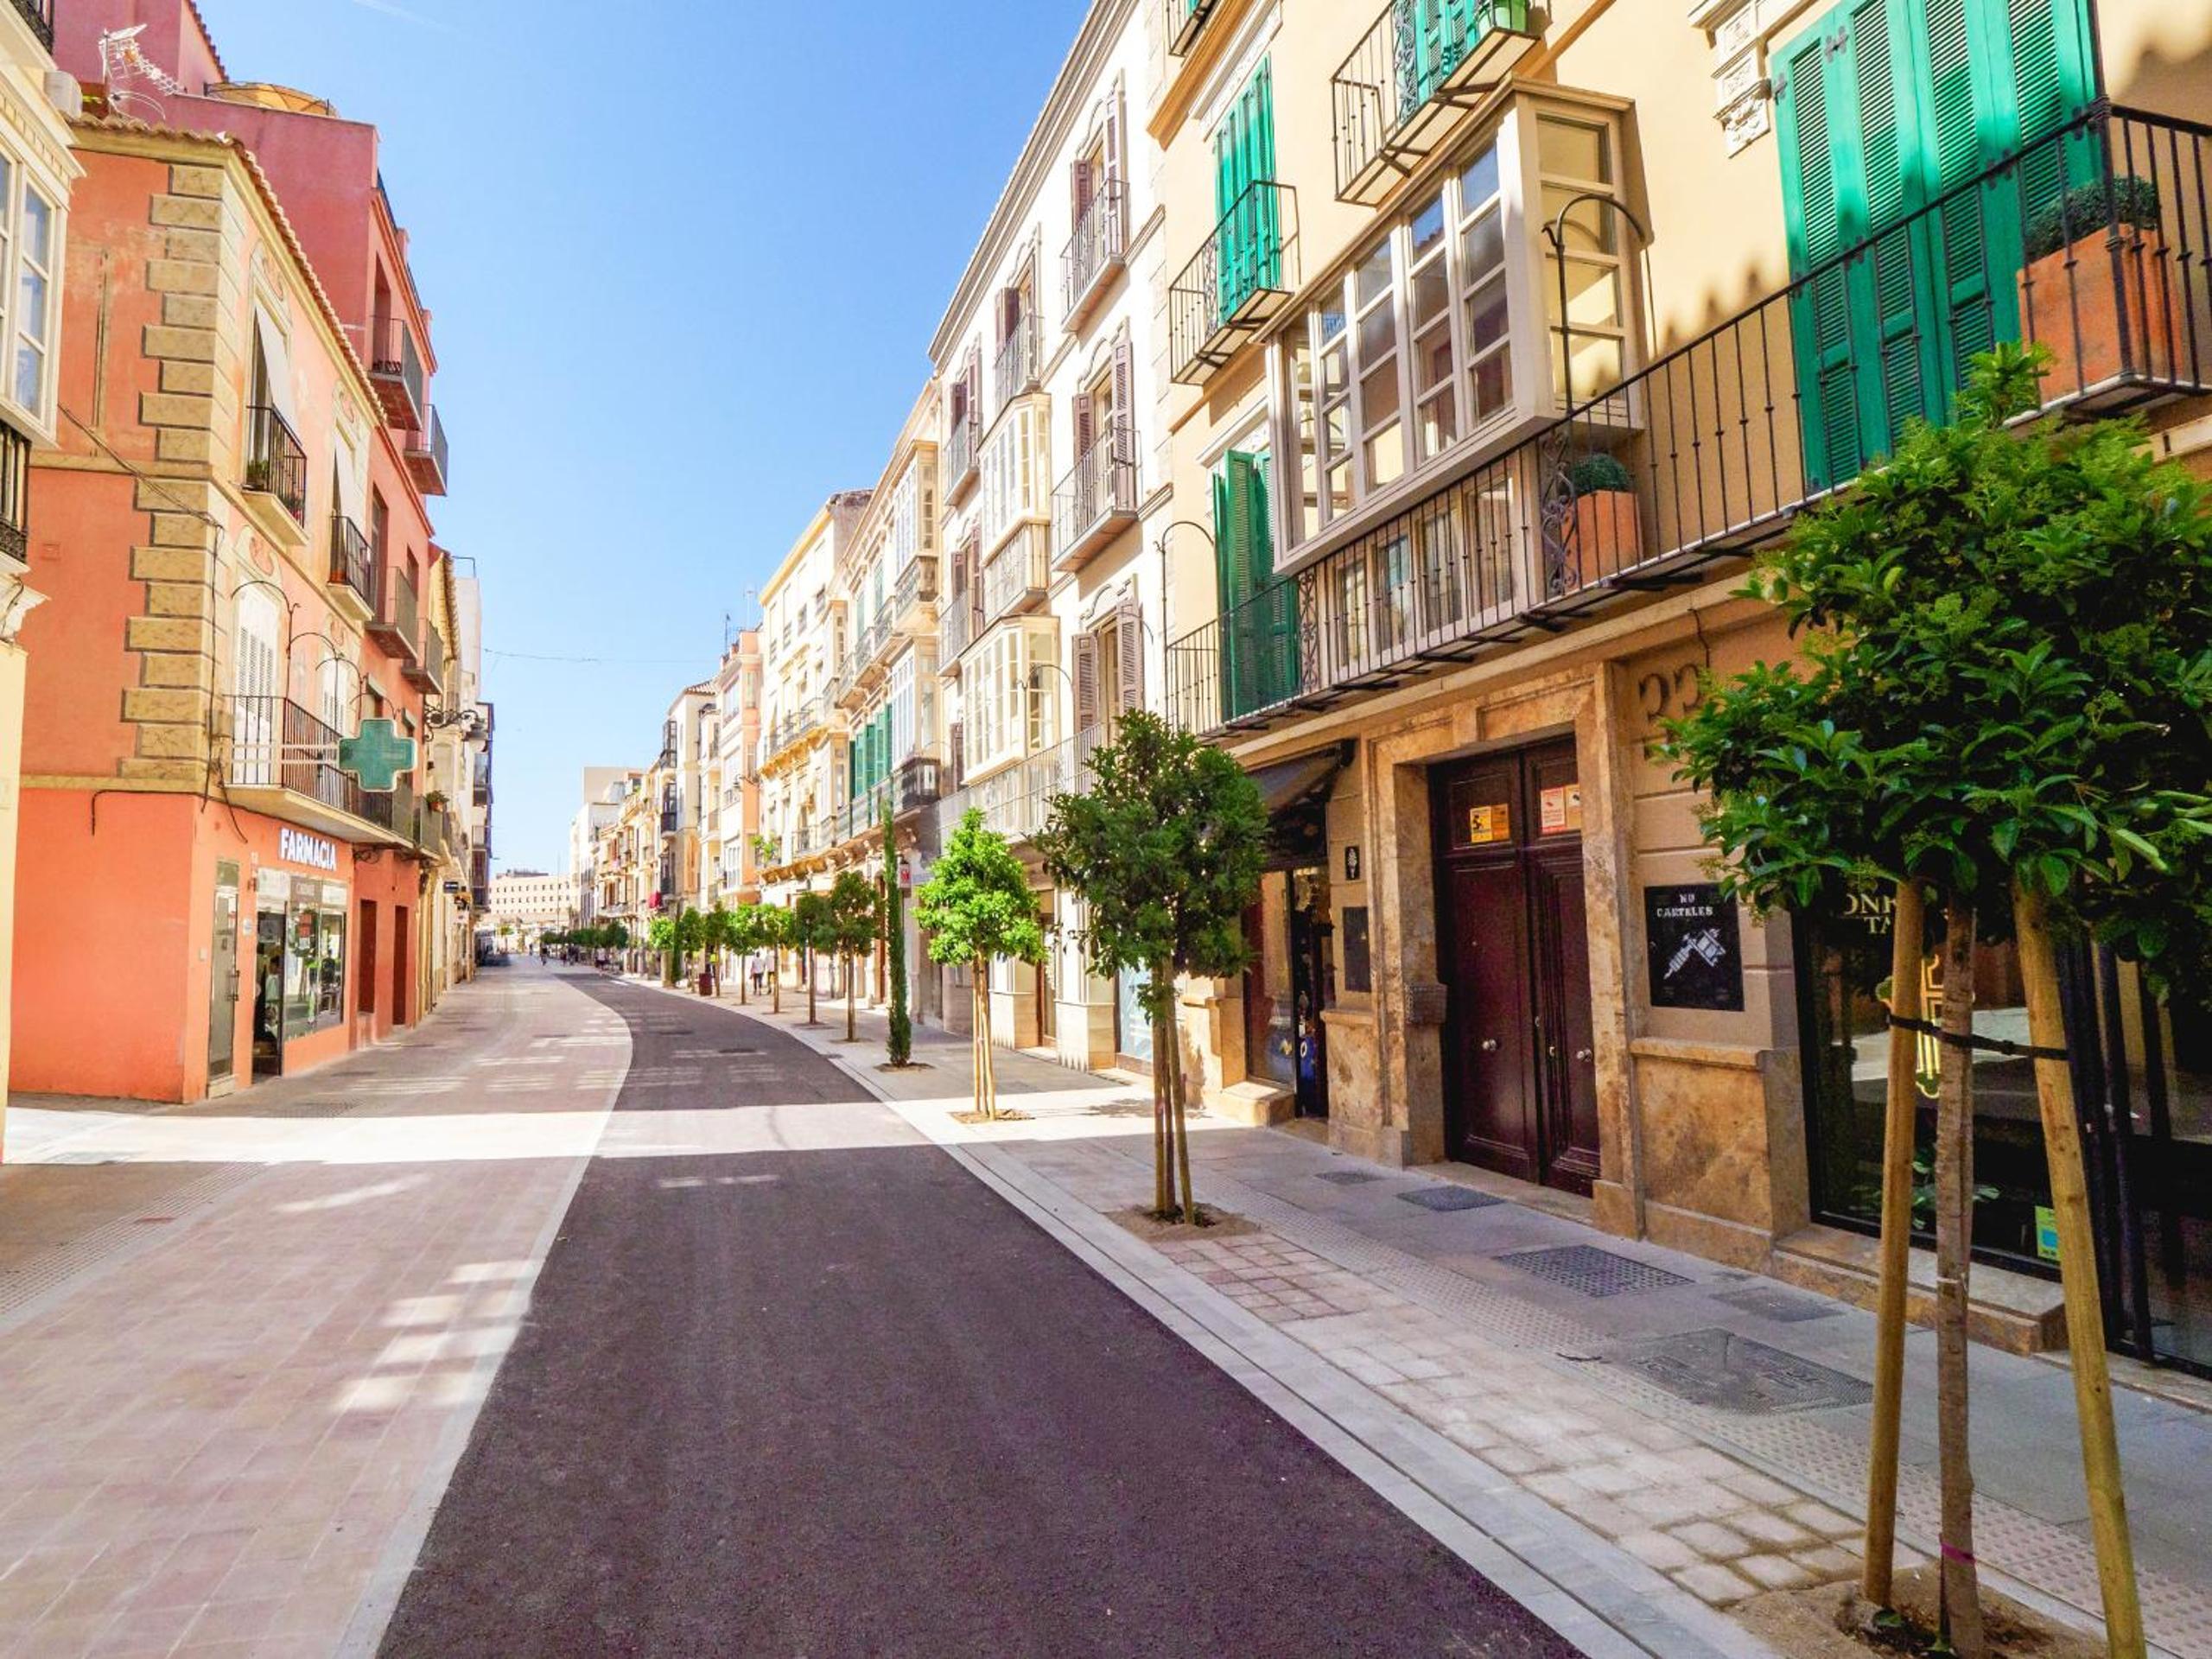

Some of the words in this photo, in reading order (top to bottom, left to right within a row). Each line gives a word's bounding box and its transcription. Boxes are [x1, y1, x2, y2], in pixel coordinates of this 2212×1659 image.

[280, 828, 337, 871] FARMACIA
[1680, 893, 1695, 904] NO
[1656, 906, 1713, 918] CARTELES
